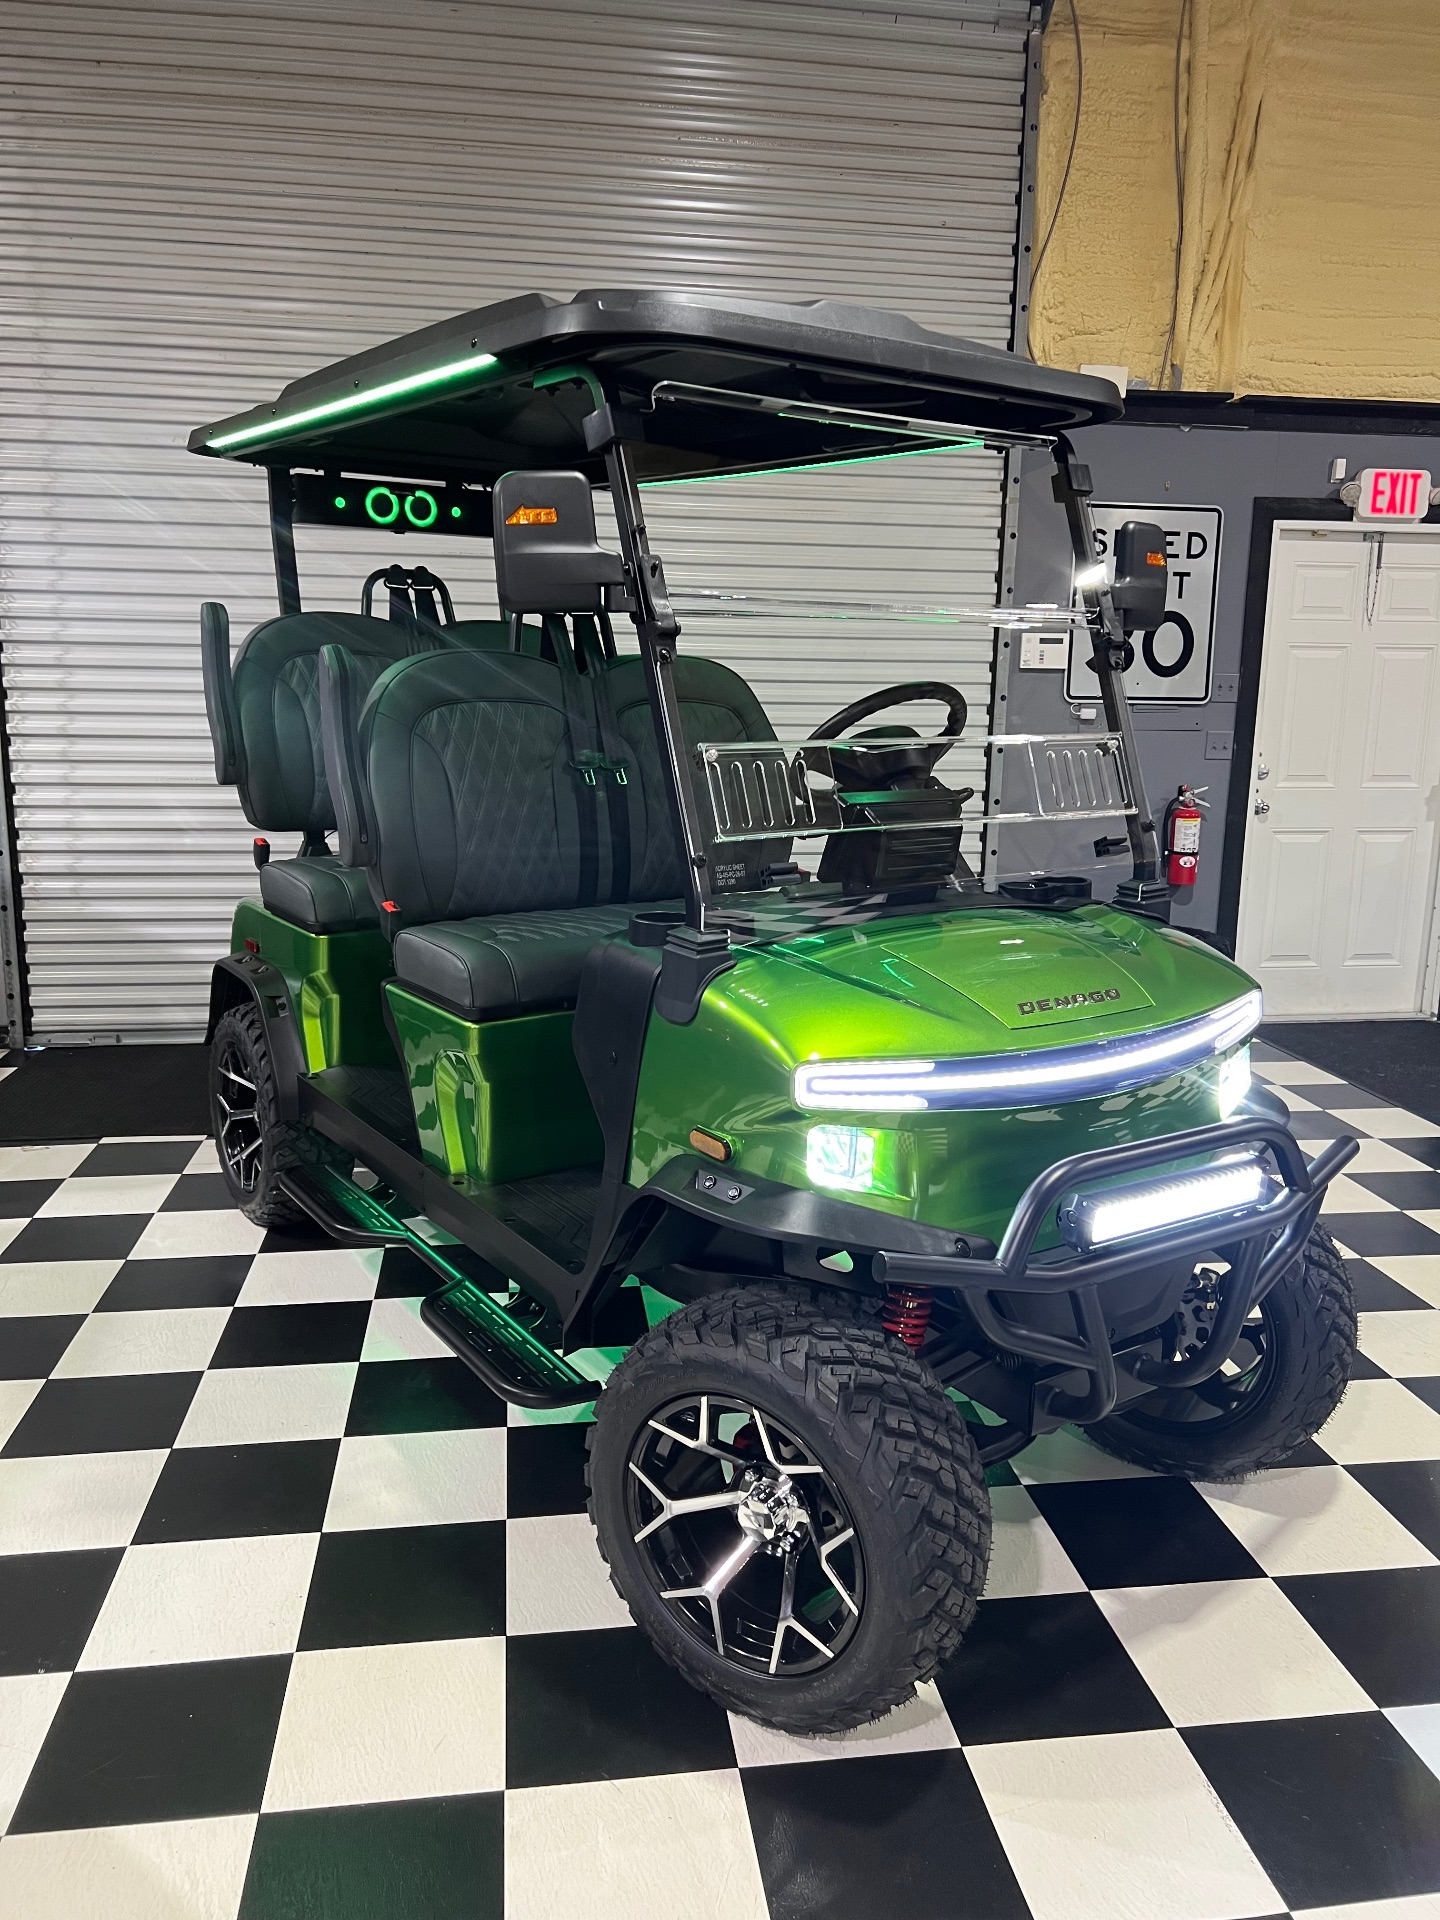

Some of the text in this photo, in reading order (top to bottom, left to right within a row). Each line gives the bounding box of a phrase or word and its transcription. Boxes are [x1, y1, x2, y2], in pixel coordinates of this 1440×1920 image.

[1370, 472, 1423, 515] EXIT
[1091, 528, 1208, 559] SED
[1017, 988, 1121, 1015] DENAGO
